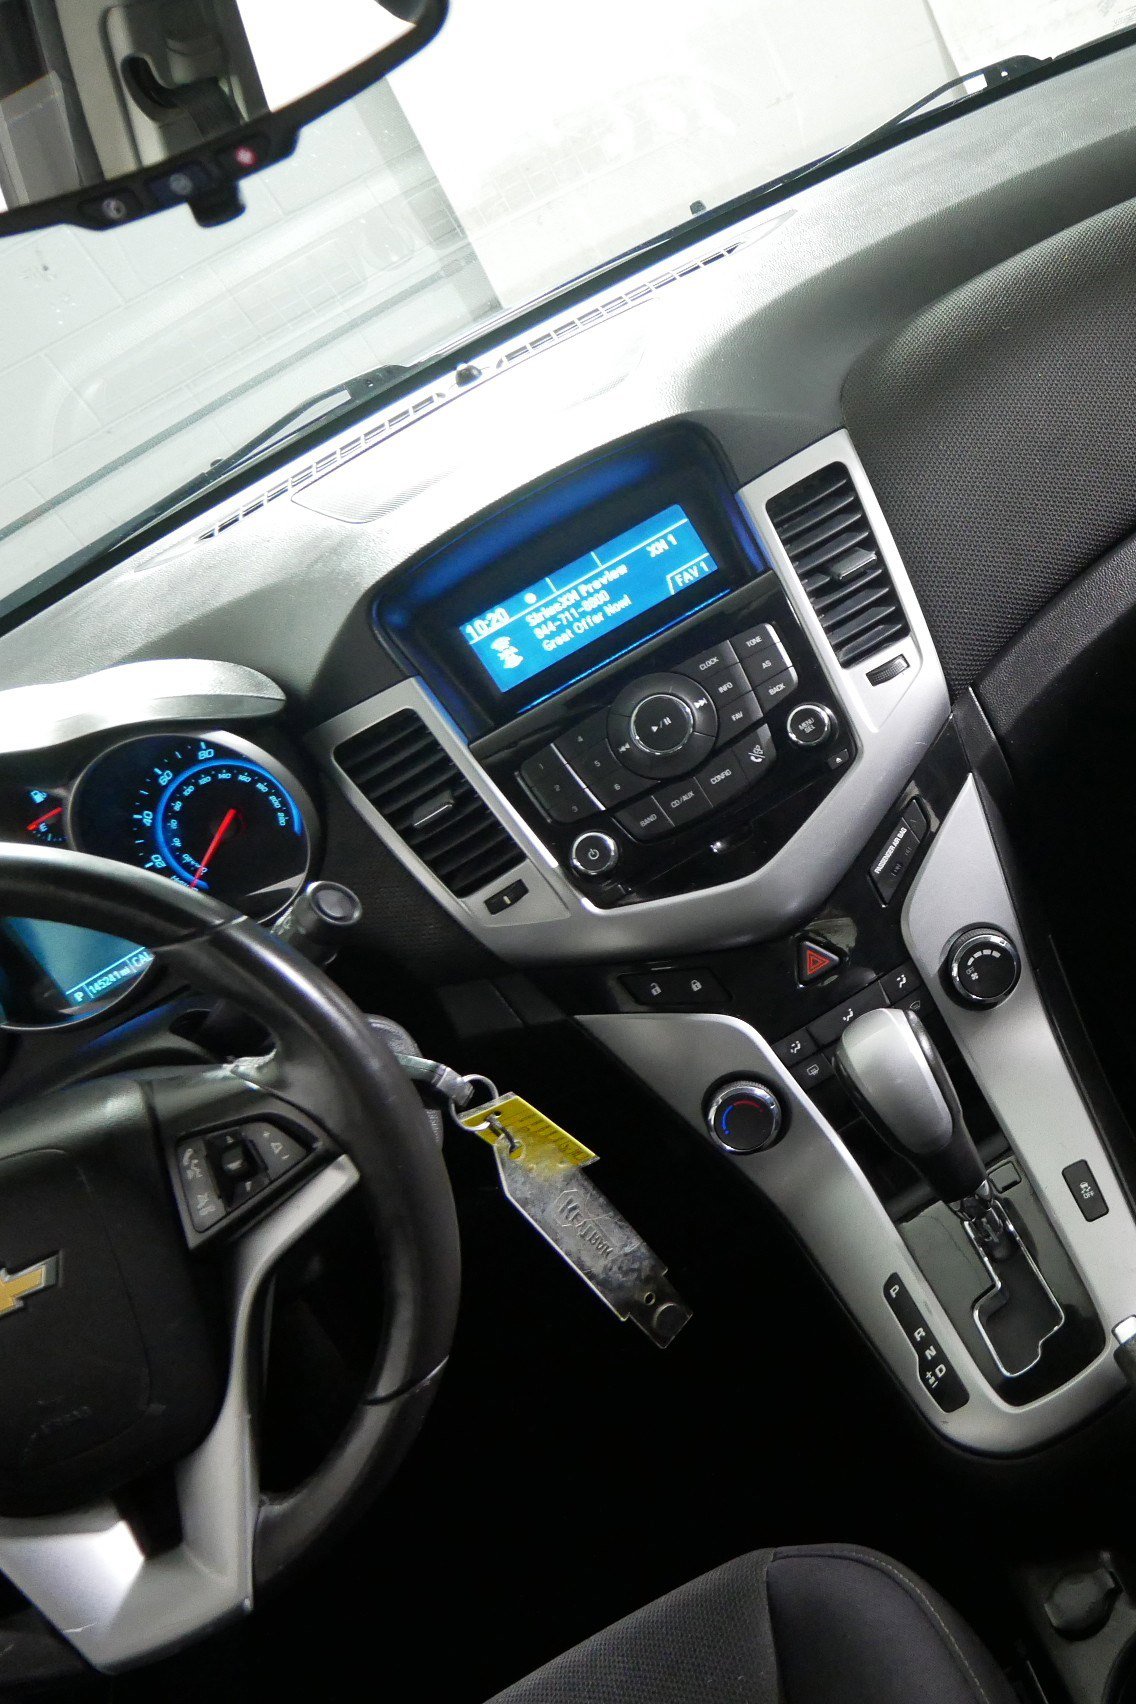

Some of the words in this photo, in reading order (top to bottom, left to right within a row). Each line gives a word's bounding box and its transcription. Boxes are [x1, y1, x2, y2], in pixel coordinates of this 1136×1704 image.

[667, 533, 678, 546] 1
[577, 564, 629, 597] Preview
[674, 565, 699, 587] FAV
[699, 560, 709, 572] 1
[465, 607, 511, 640] 10:20
[541, 628, 575, 652] Great
[572, 611, 604, 635] Offer
[745, 635, 763, 648] TONE
[698, 656, 719, 671] CLOCK
[761, 660, 772, 669] AS
[717, 682, 733, 694] INFO
[768, 682, 786, 696] BACK
[731, 711, 743, 721] FAV
[798, 717, 815, 731] MENU
[197, 749, 215, 760] 80
[158, 770, 174, 786] 60
[199, 776, 212, 785] 120
[238, 774, 252, 783] 160
[183, 785, 195, 797] 100
[670, 790, 695, 809] CD/AUX
[142, 810, 154, 827] 40
[639, 813, 657, 828] BAND
[874, 845, 896, 874] PASSENGER
[892, 837, 901, 848] AIR
[897, 827, 908, 839] BAG
[151, 854, 167, 868] 20
[73, 991, 84, 1002] P
[89, 970, 122, 993] 145241
[889, 1284, 900, 1298] P
[914, 1327, 926, 1341] R
[924, 1345, 937, 1360] N
[934, 1363, 947, 1378] D
